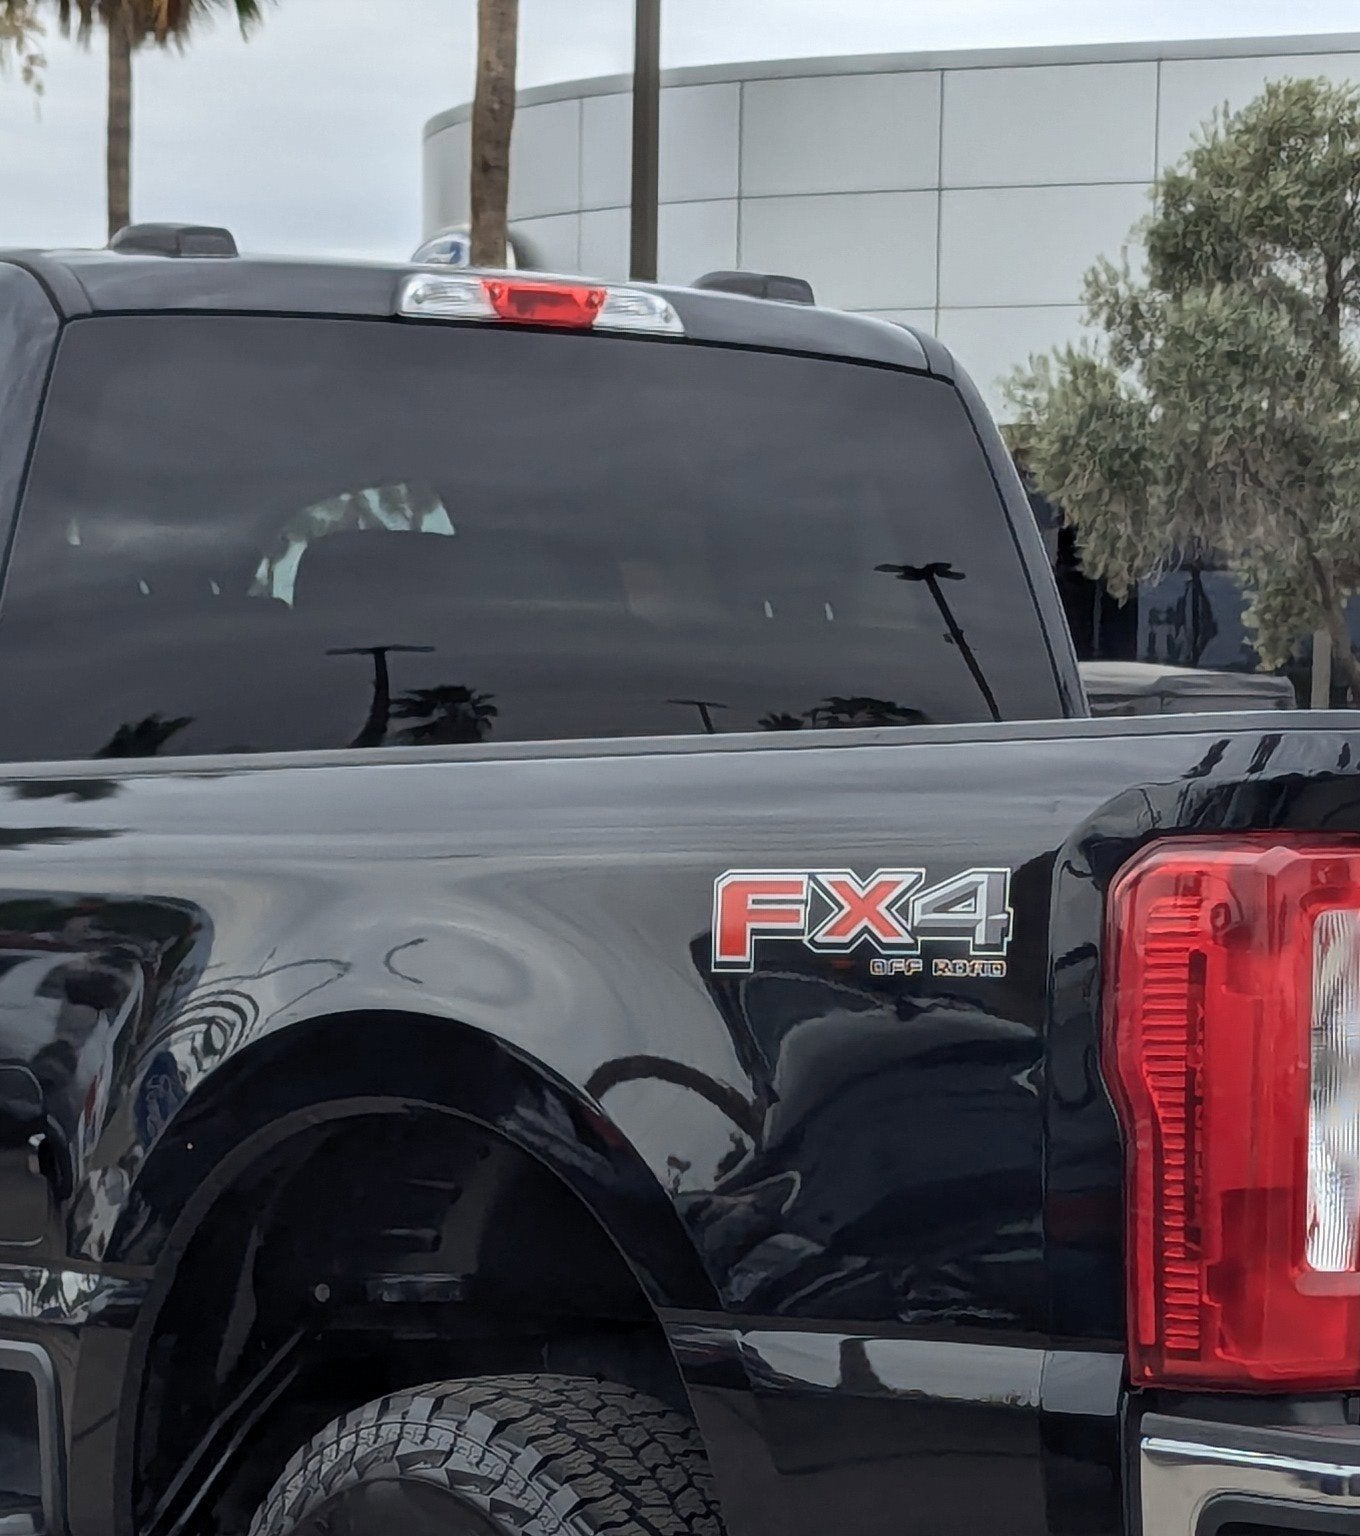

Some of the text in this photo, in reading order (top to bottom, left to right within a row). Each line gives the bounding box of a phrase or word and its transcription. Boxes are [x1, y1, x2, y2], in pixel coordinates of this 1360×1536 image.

[711, 868, 1013, 972] FX4
[870, 959, 1007, 977] OFF ROAD
